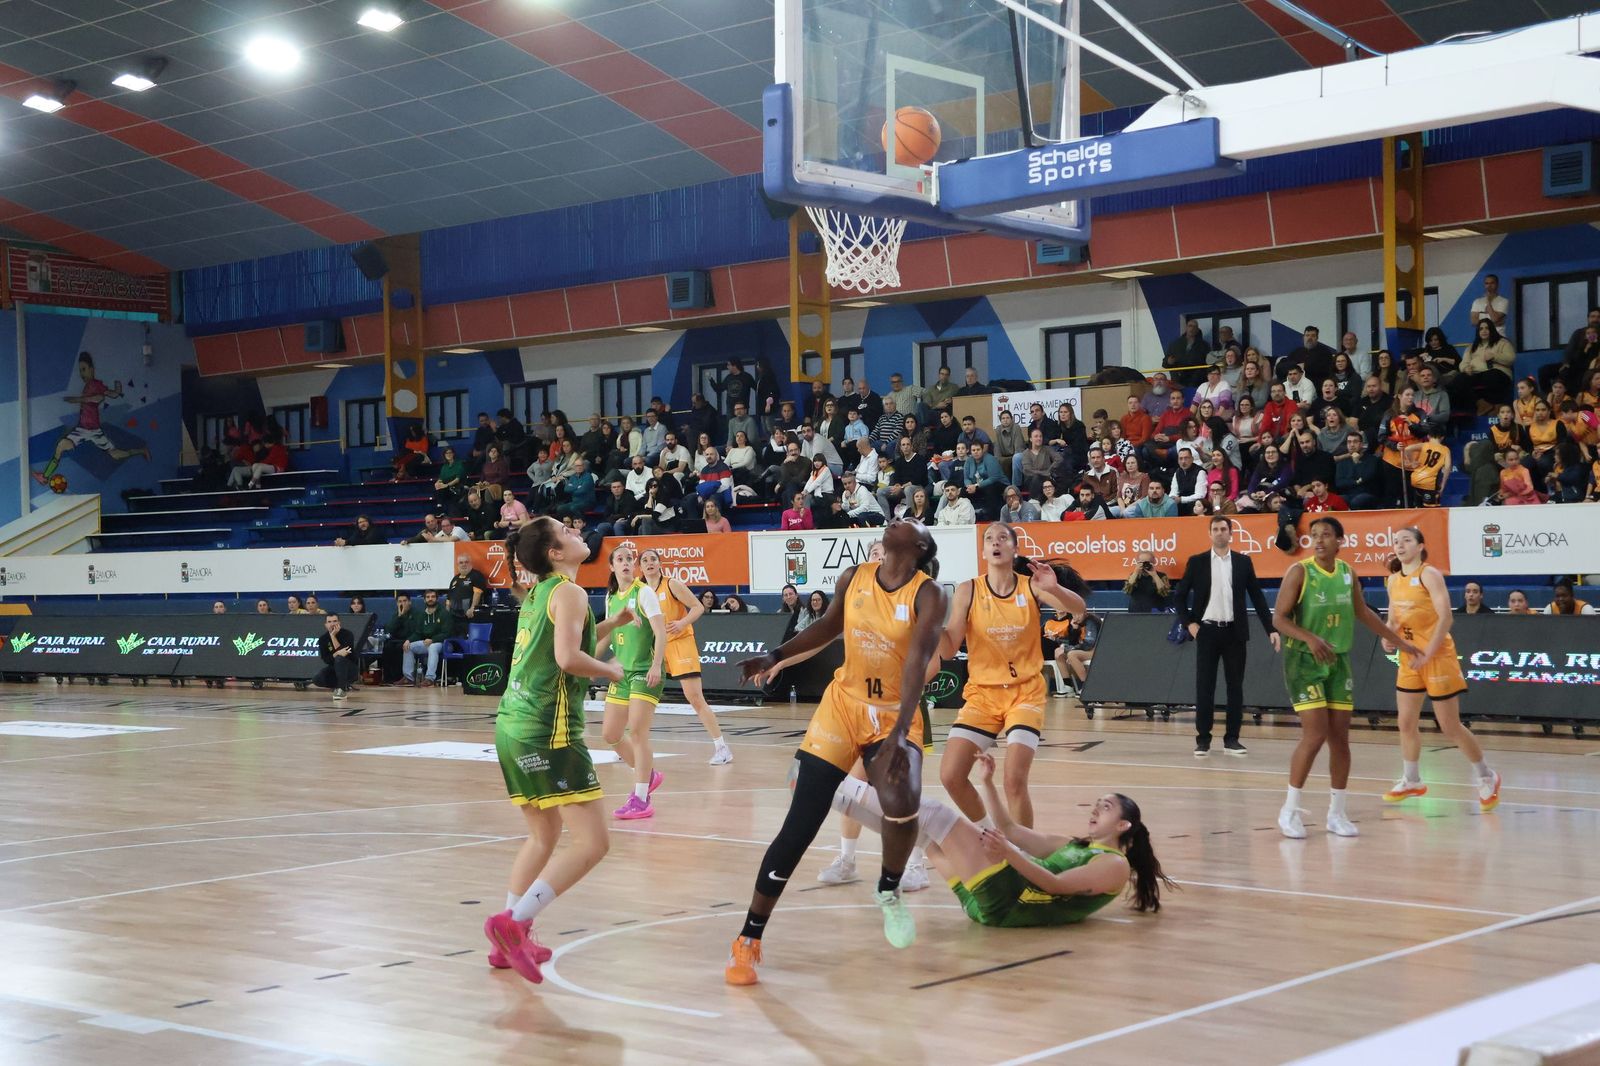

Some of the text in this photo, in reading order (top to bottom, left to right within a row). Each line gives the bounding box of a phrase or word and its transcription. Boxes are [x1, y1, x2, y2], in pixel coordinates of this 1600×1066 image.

[1028, 142, 1112, 168] Schelde
[1028, 158, 1113, 186] Sports
[1013, 412, 1026, 425] DE
[1423, 448, 1441, 468] 18
[1048, 532, 1177, 555] recoletas salud
[1504, 532, 1568, 548] ZAMORA
[402, 561, 432, 572] ZAMORA
[1122, 557, 1177, 567] ZAORA
[95, 570, 117, 579] ZAMORA
[189, 567, 213, 578] ZAMORA
[291, 564, 317, 575] ZAMORA
[1326, 613, 1341, 628] 31
[37, 636, 106, 646] CAJA RURAL
[147, 636, 220, 646] CAJA RURAL
[267, 637, 299, 647] CAJA
[702, 641, 768, 653] RURAL
[277, 649, 319, 657] ZAMORA
[1470, 650, 1552, 668] CAJA
[1008, 661, 1018, 678] 5
[1466, 669, 1500, 681] DE
[865, 677, 883, 699] 14
[1307, 684, 1324, 700] 31
